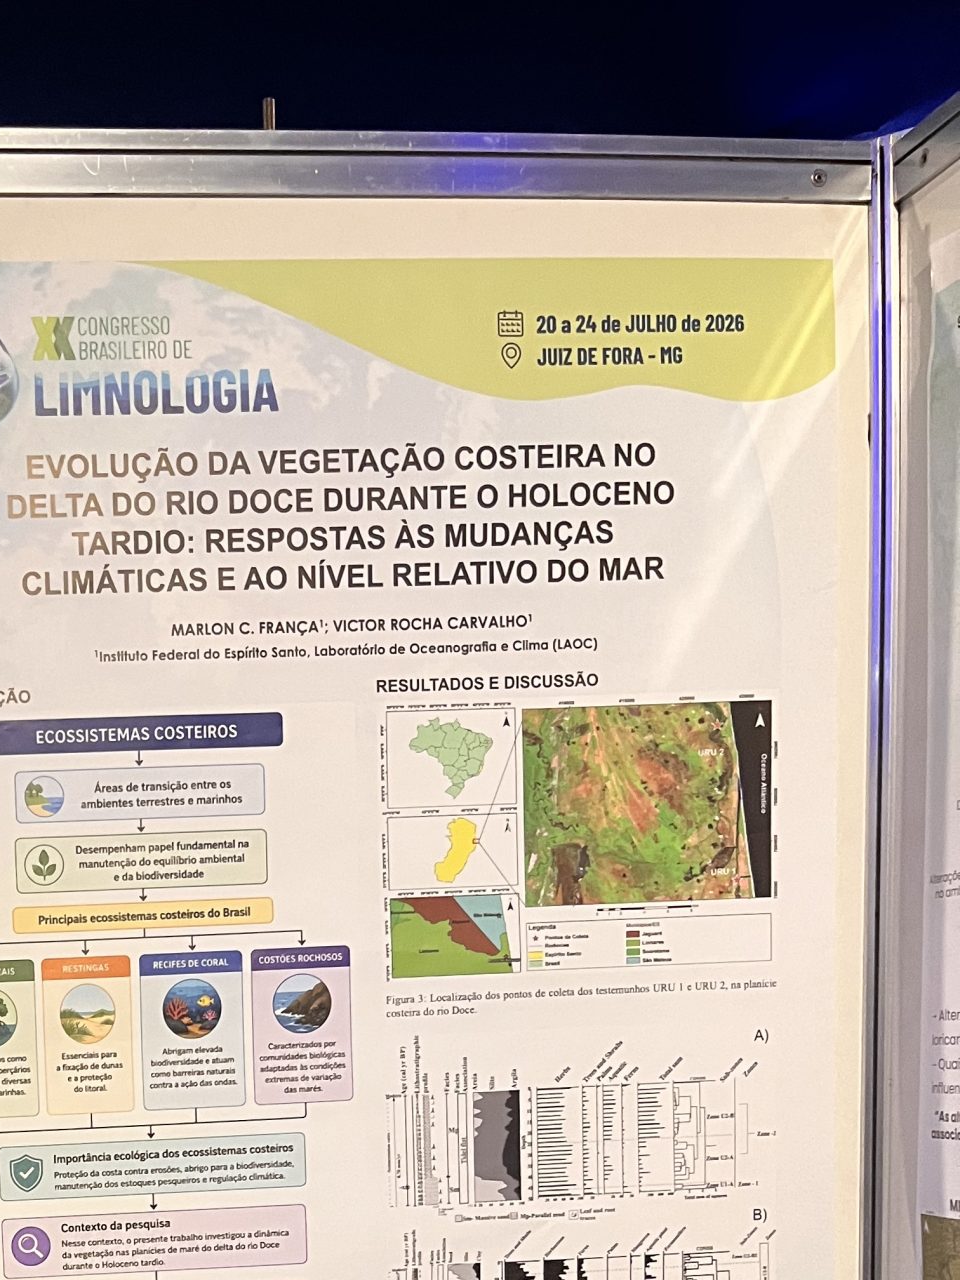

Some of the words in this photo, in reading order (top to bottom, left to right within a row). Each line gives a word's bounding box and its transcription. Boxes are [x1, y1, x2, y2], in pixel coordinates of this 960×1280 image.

[78, 316, 170, 336] CONGRESSO
[536, 315, 556, 333] 20
[561, 319, 571, 333] a
[575, 314, 597, 333] 24
[601, 314, 620, 333] de
[625, 313, 676, 333] JULHO
[681, 314, 700, 332] de
[705, 313, 744, 332] 2026
[79, 340, 167, 361] BRASILEIRO
[173, 340, 193, 359] DE
[536, 347, 572, 366] JUIZ
[577, 347, 597, 365] DE
[602, 346, 643, 365] FORA
[660, 346, 682, 364] MG
[34, 368, 279, 417] LIMNOLOGIA
[26, 447, 197, 483] EVOLUÇÃO
[208, 450, 250, 475] DA
[257, 442, 444, 478] VEGETAÇÃO
[454, 443, 605, 470] COSTEIRA
[614, 442, 655, 466] NO
[7, 492, 104, 518] DELTA
[112, 491, 155, 516] DO
[166, 489, 218, 515] RIO
[228, 488, 313, 514] DOCE
[323, 484, 466, 511] DURANTE
[477, 483, 498, 508] O
[508, 480, 674, 507] HOLOCENO
[71, 529, 193, 555] TARDIO:
[205, 524, 385, 553] RESPOSTAS
[394, 518, 434, 548] ÀS
[445, 519, 613, 551] MUDANÇAS
[22, 563, 207, 595] CLIMÁTICAS
[217, 566, 235, 590] E
[243, 565, 287, 590] AO
[297, 558, 383, 589] NÍVEL
[393, 559, 537, 586] RELATIVO
[547, 558, 588, 582] DO
[599, 556, 664, 581] MAR
[171, 622, 233, 636] MARLON
[238, 621, 254, 634] C.
[332, 618, 385, 632] VICTOR
[390, 617, 442, 630] ROCHA
[152, 648, 199, 660] Federal
[203, 648, 220, 659] do
[224, 645, 267, 661] Espírito
[271, 646, 310, 657] Santo,
[314, 642, 385, 656] Laboratório
[389, 643, 405, 654] de
[409, 640, 496, 655] Oceanografia
[500, 642, 508, 651] e
[512, 639, 548, 651] Clima
[552, 637, 597, 652] (LAOC)
[376, 676, 484, 692] RESULTADOS
[489, 676, 499, 689] E
[504, 670, 598, 689] DISCUSSÃO
[35, 726, 149, 743] ECOSSISTEMAS
[154, 723, 237, 740] COSTEIROS
[94, 780, 123, 793] Áreas
[125, 782, 138, 792] de
[141, 780, 188, 793] transição
[190, 780, 216, 789] entre
[80, 798, 133, 808] ambientes
[136, 797, 185, 806] terrestres
[187, 797, 193, 805] e
[196, 794, 242, 804] marinhos
[75, 843, 145, 855] Desempenham
[148, 841, 174, 853] papel
[176, 839, 235, 850] fundamental
[38, 913, 87, 925] Principais
[89, 911, 157, 922] ecossistemas
[159, 908, 205, 919] costeiros
[207, 907, 220, 918] do
[222, 906, 250, 917] Brasil
[62, 962, 109, 972] RESTINGAS
[152, 959, 186, 968] RECIFES
[187, 959, 199, 967] DE
[200, 958, 228, 966] CORAL
[258, 953, 295, 964] COSTÕES
[297, 952, 342, 962] ROCHOSOS
[754, 1029, 769, 1044] A)
[53, 1152, 111, 1165] Importância
[113, 1149, 159, 1161] ecológica
[161, 1148, 179, 1158] dos
[181, 1146, 247, 1157] ecossistemas
[249, 1143, 293, 1154] costeiros
[60, 1222, 107, 1232] Contexto
[109, 1220, 122, 1230] da
[125, 1218, 170, 1231] pesquisa
[753, 1208, 767, 1223] B)
